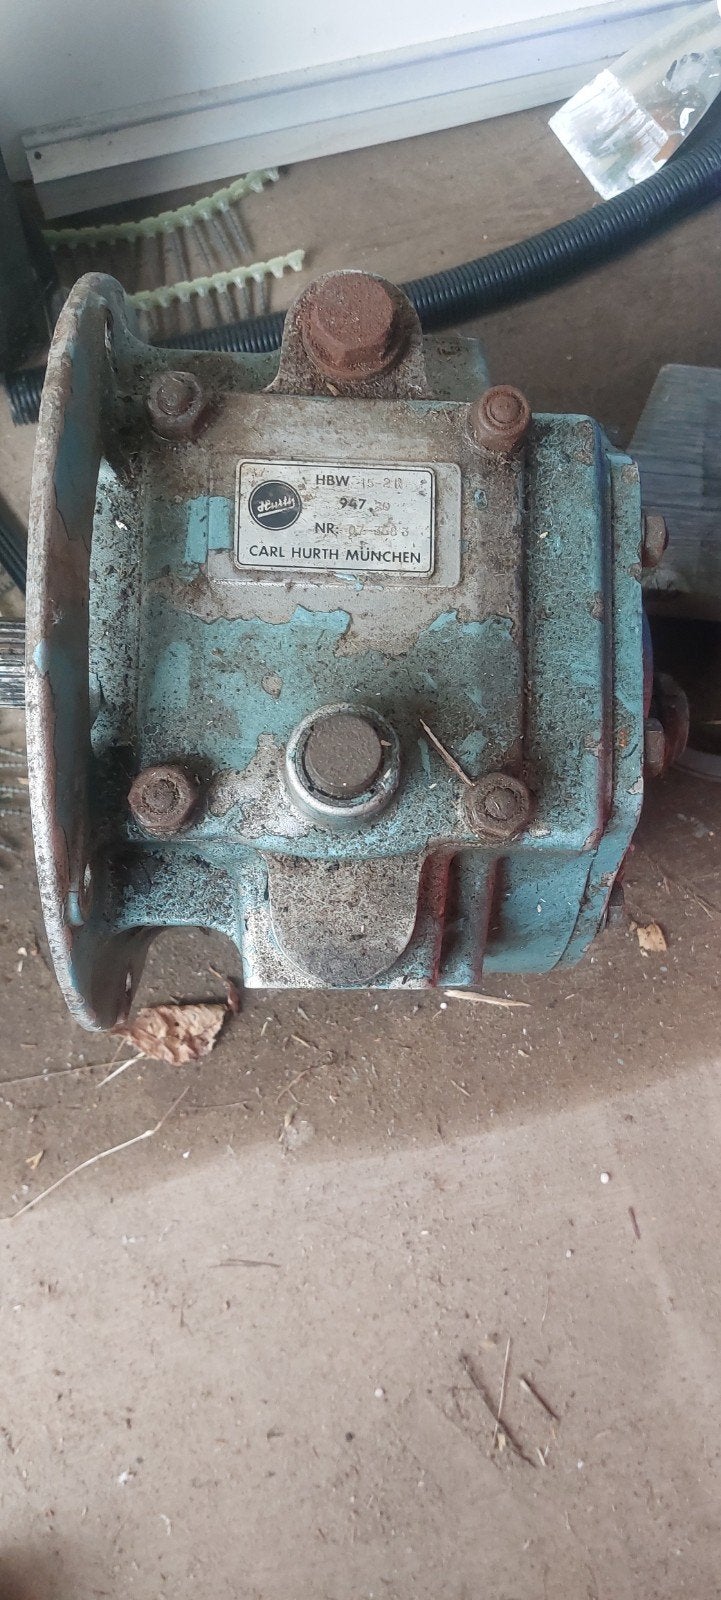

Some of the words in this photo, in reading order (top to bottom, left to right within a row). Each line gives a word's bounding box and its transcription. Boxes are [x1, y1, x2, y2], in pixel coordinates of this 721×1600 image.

[315, 474, 350, 487] HBW
[314, 522, 340, 535] NR:
[249, 545, 286, 558] CARL
[291, 547, 339, 561] HURTH
[345, 547, 422, 564] MÜNCHEN
